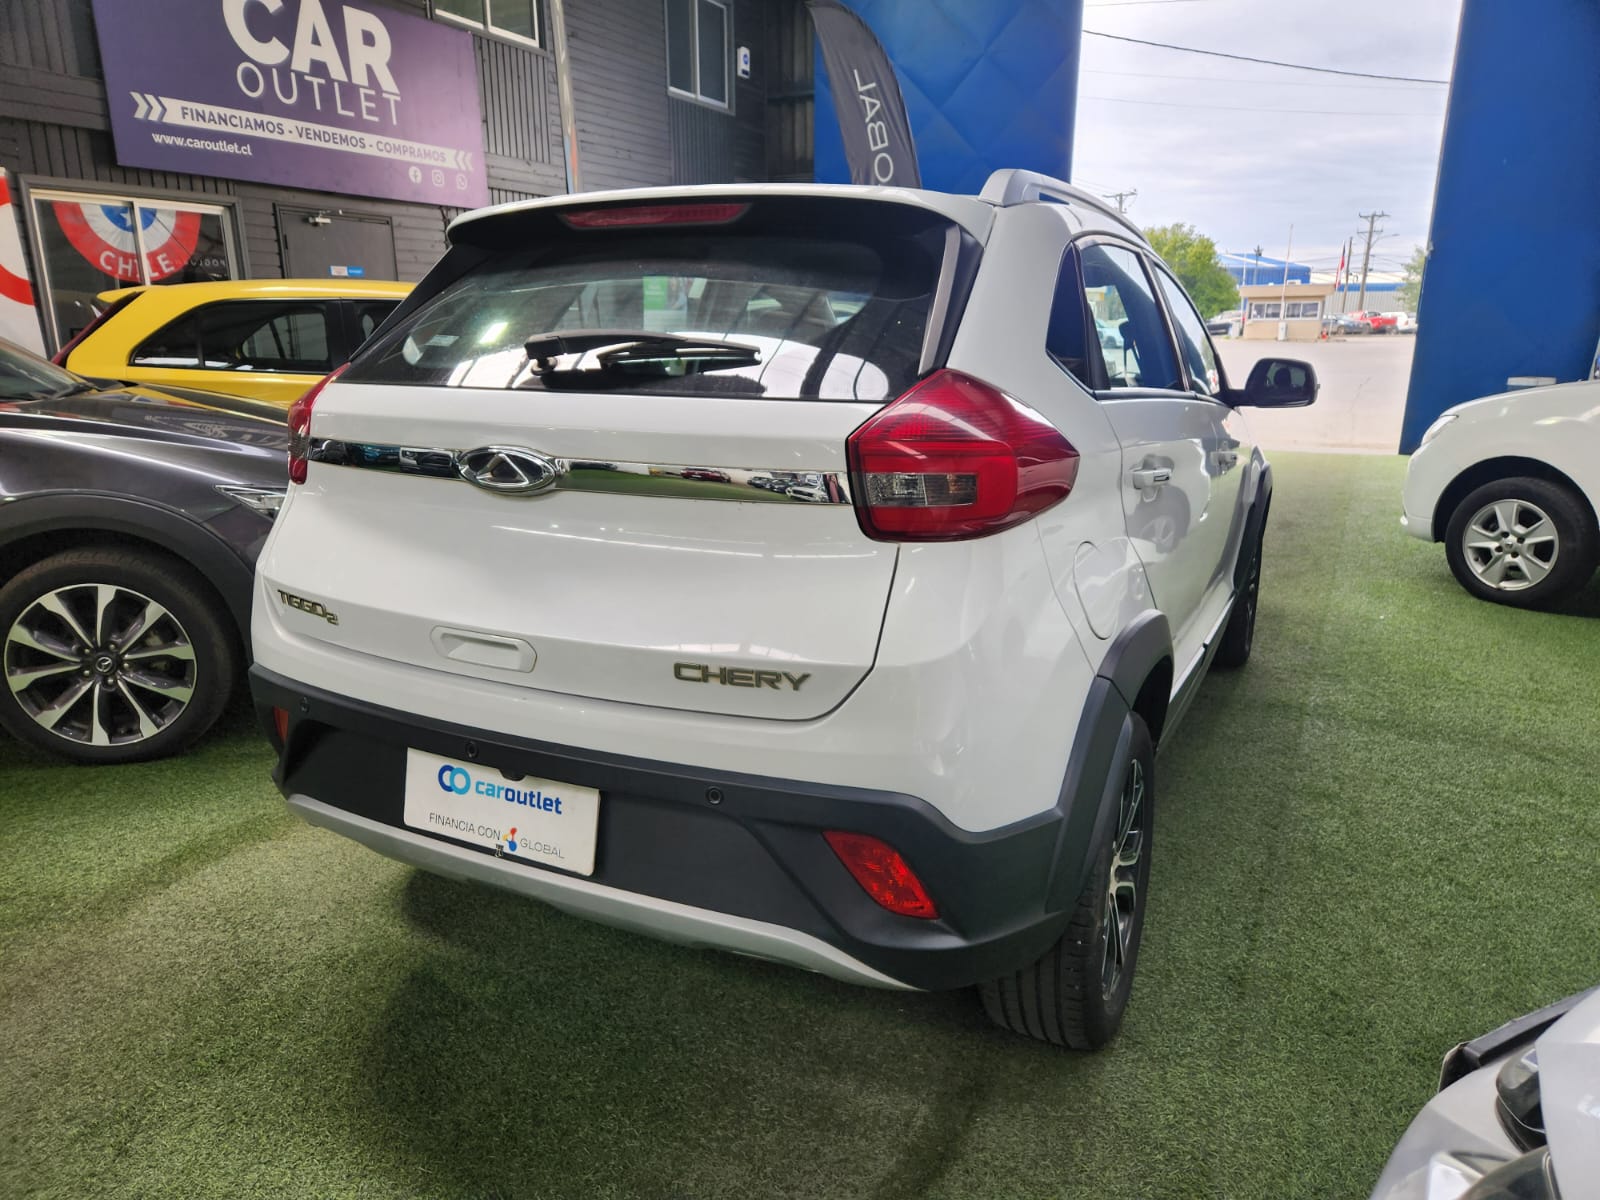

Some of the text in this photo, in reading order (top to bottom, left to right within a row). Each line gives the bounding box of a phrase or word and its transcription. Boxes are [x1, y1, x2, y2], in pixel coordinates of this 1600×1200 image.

[223, 0, 400, 94] CAR
[236, 61, 401, 126] OUTLET
[151, 133, 253, 156] www.caroutlet.cl
[181, 106, 285, 135] FINANCIAMOS
[295, 125, 366, 149] VENDEMOS
[376, 140, 447, 163] COMPRAMOS
[673, 662, 812, 692] CHERY
[429, 812, 566, 860] FINANCIA CON GLOBAL
